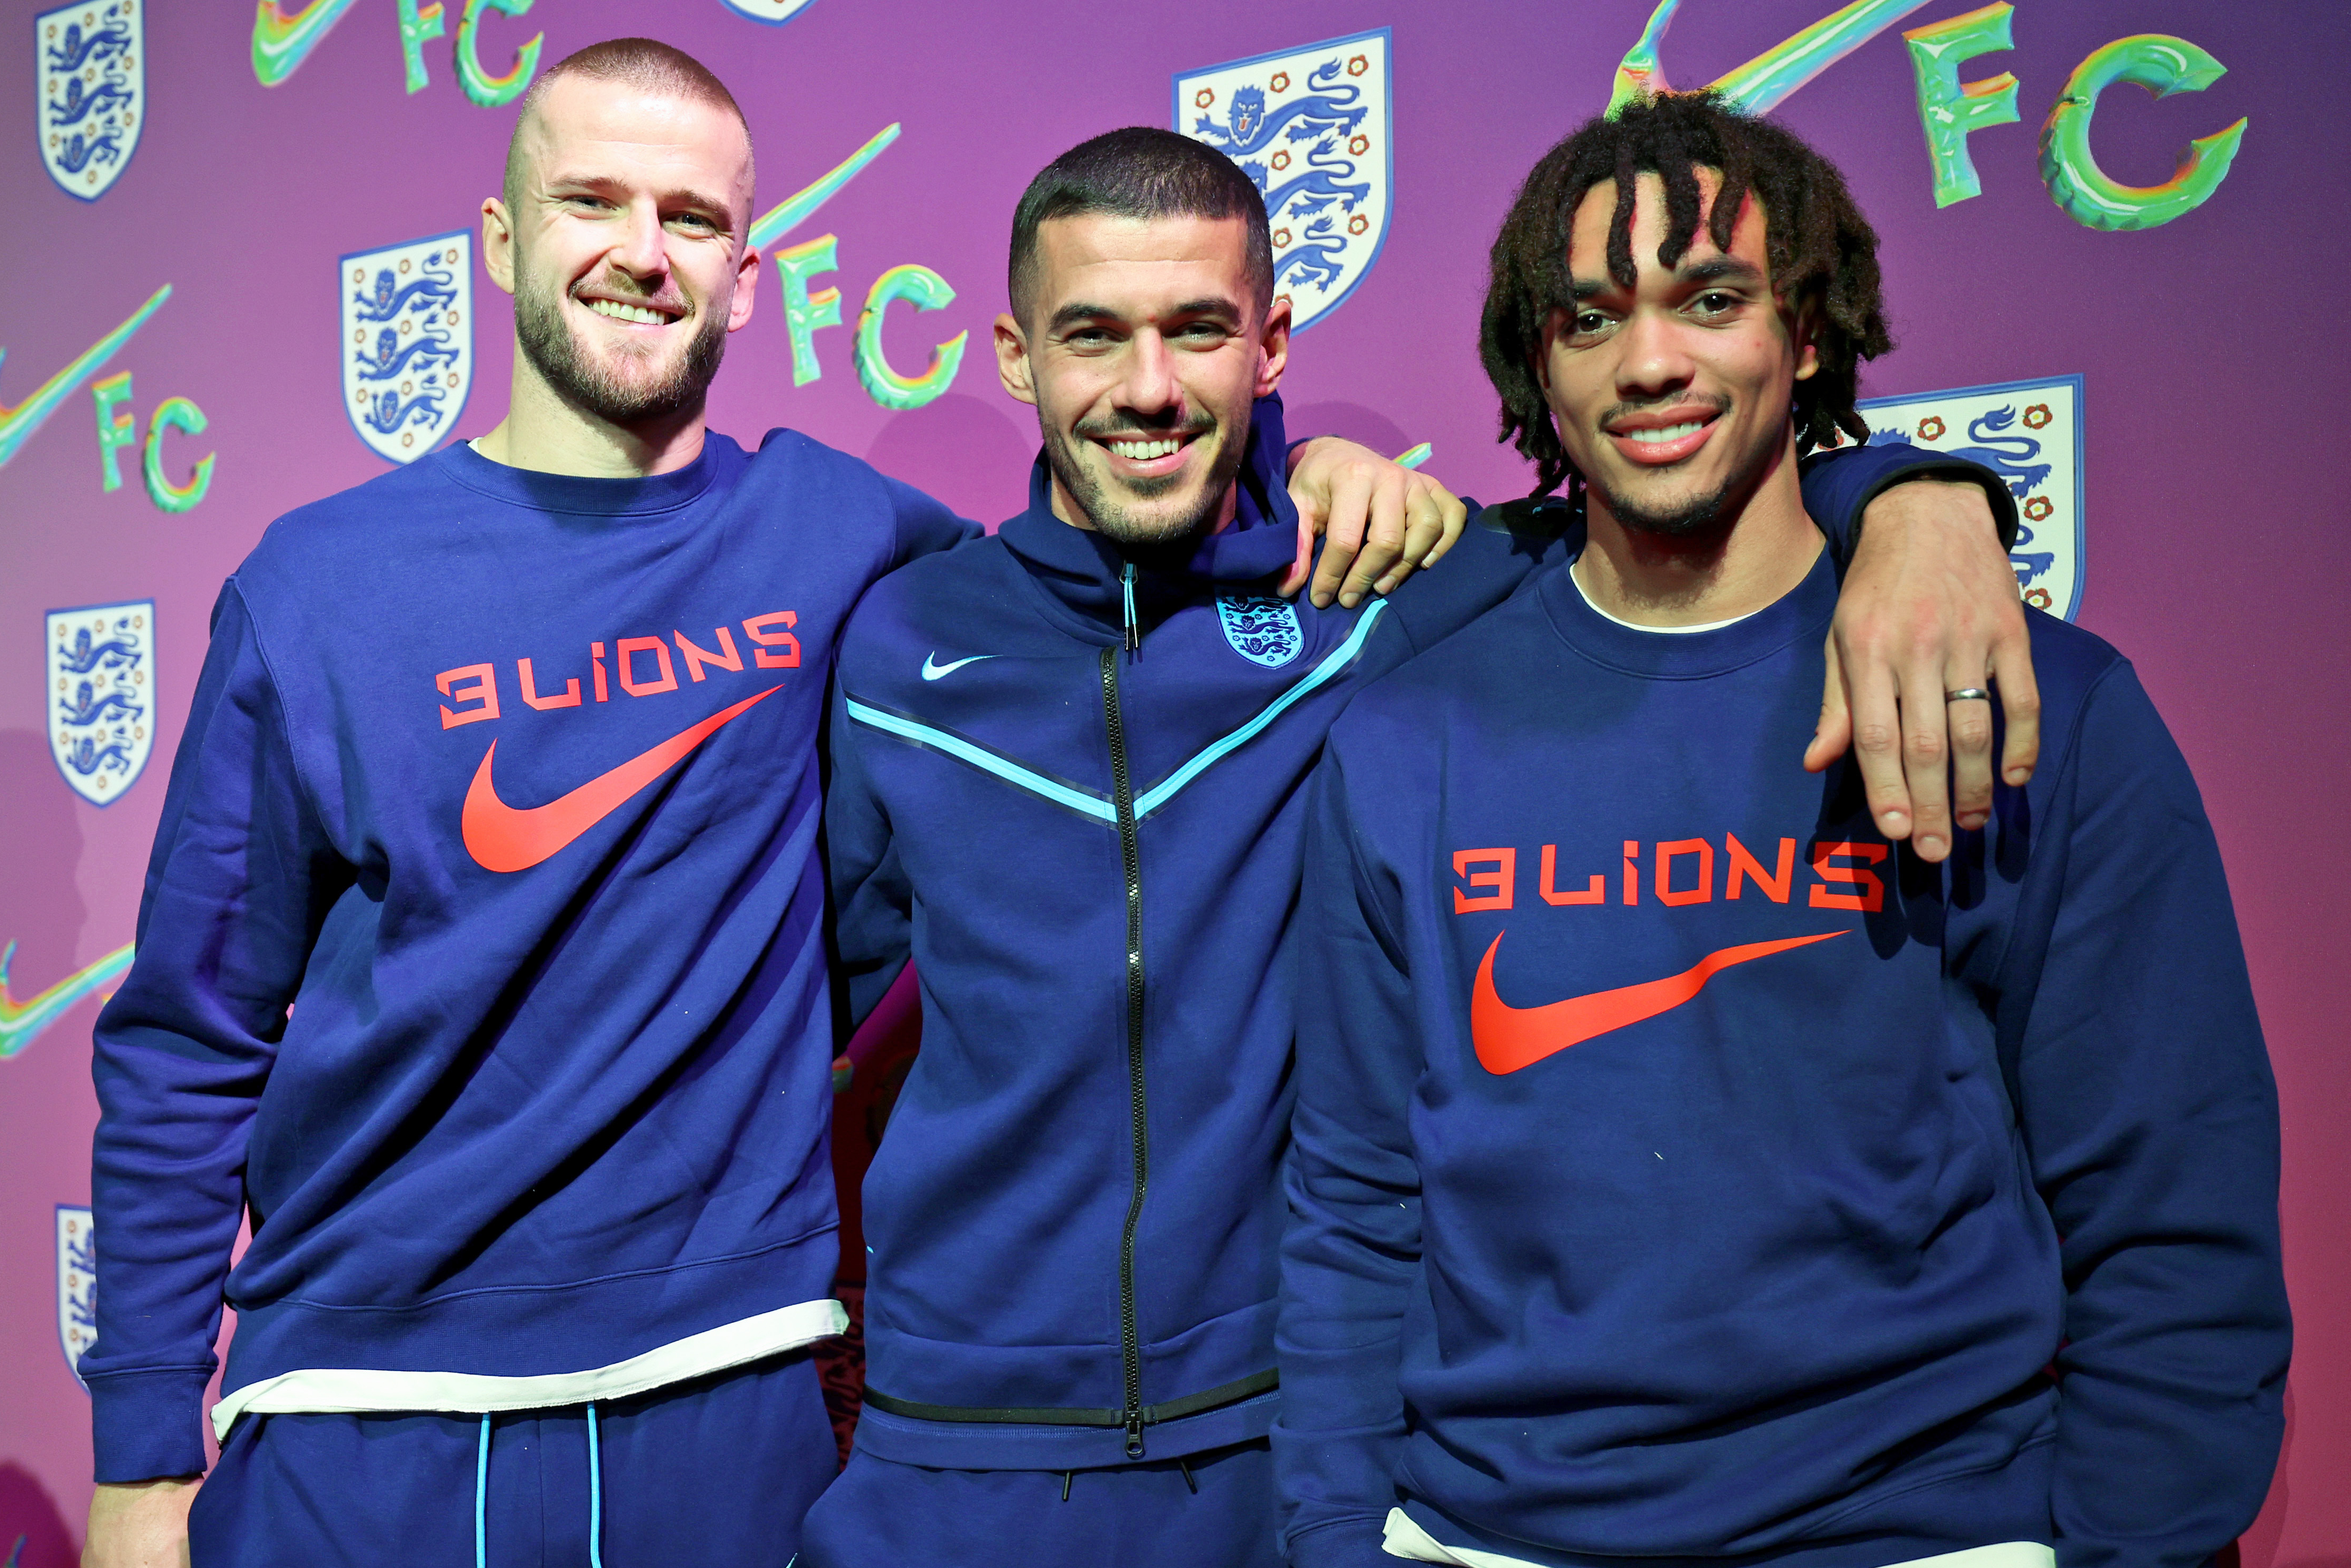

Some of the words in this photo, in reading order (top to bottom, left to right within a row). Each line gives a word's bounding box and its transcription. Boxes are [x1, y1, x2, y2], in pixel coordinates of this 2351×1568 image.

[1901, 0, 2248, 232] FC
[774, 233, 968, 410] FC
[92, 371, 216, 514] FC
[435, 663, 500, 730] 3
[1453, 848, 1515, 914] 3
